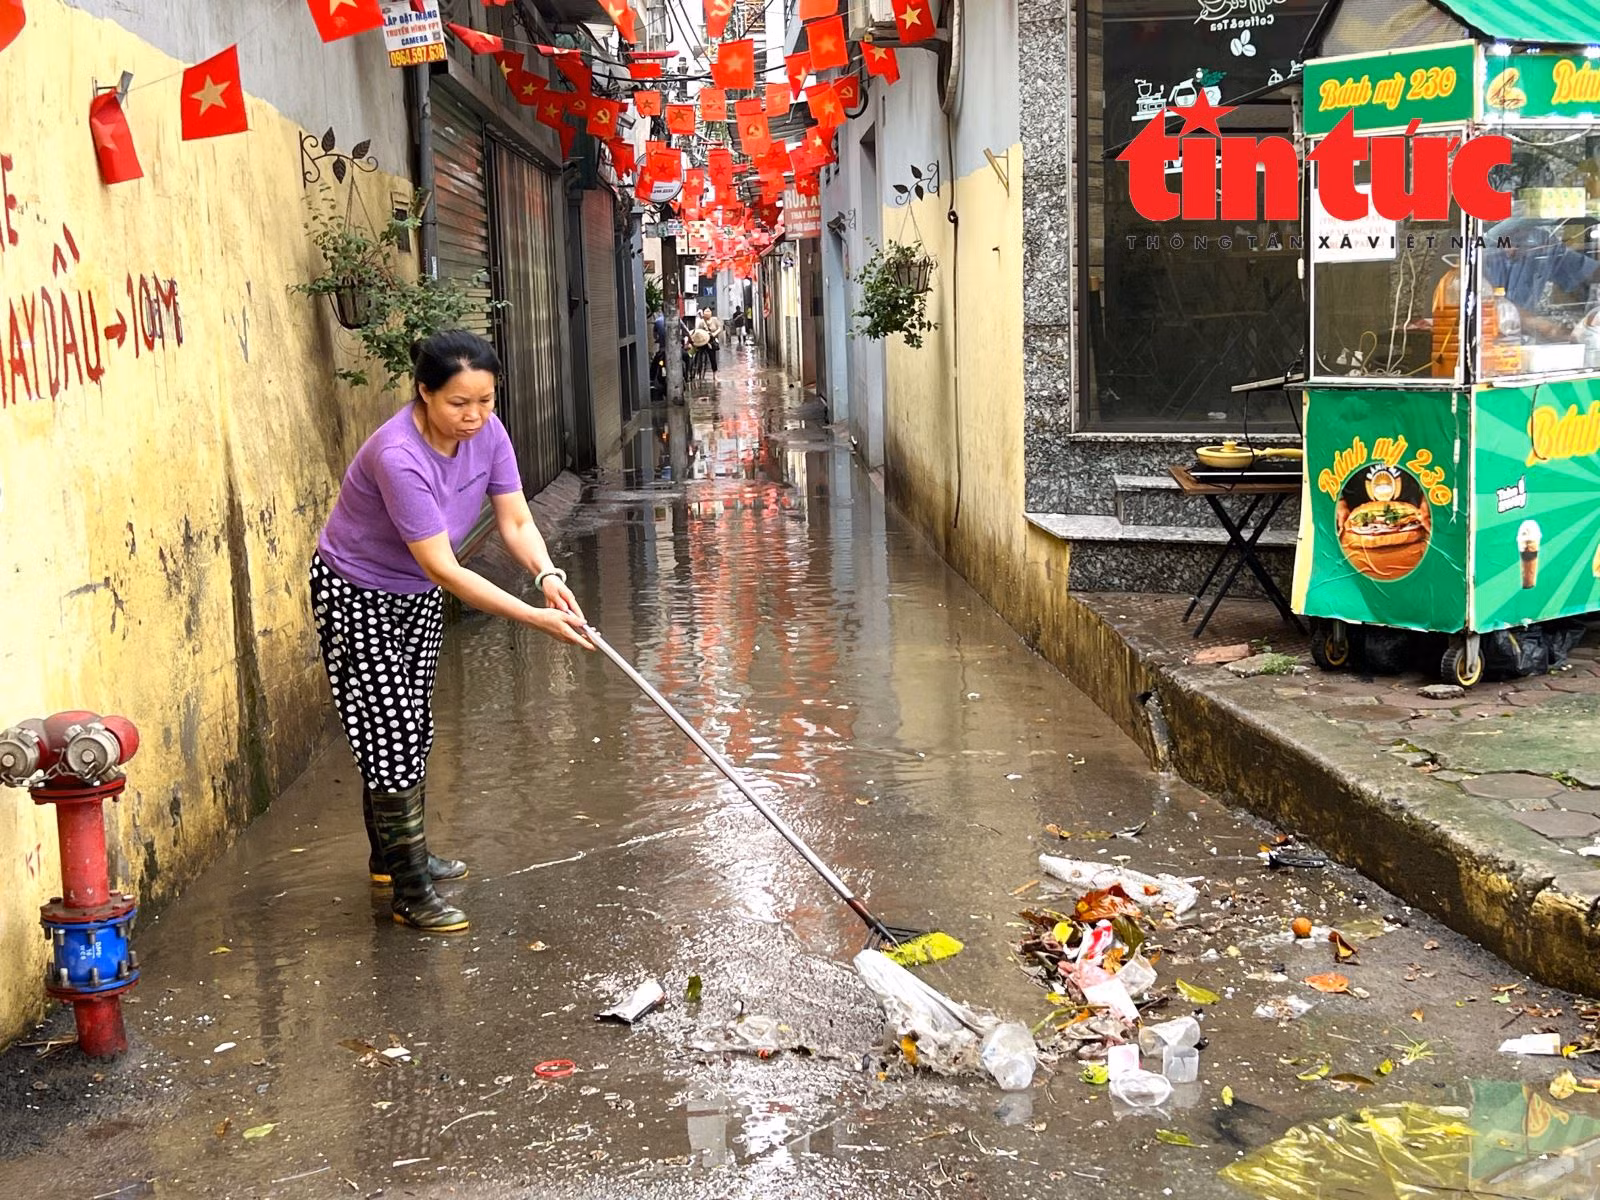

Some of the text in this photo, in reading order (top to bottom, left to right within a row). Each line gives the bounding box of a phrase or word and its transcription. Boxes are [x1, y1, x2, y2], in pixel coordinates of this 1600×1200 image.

[401, 35, 428, 46] CAMERA
[1319, 75, 1372, 111] Bánh
[1406, 66, 1456, 100] 230
[1318, 436, 1367, 502] Bánh
[1406, 448, 1451, 506] 230
